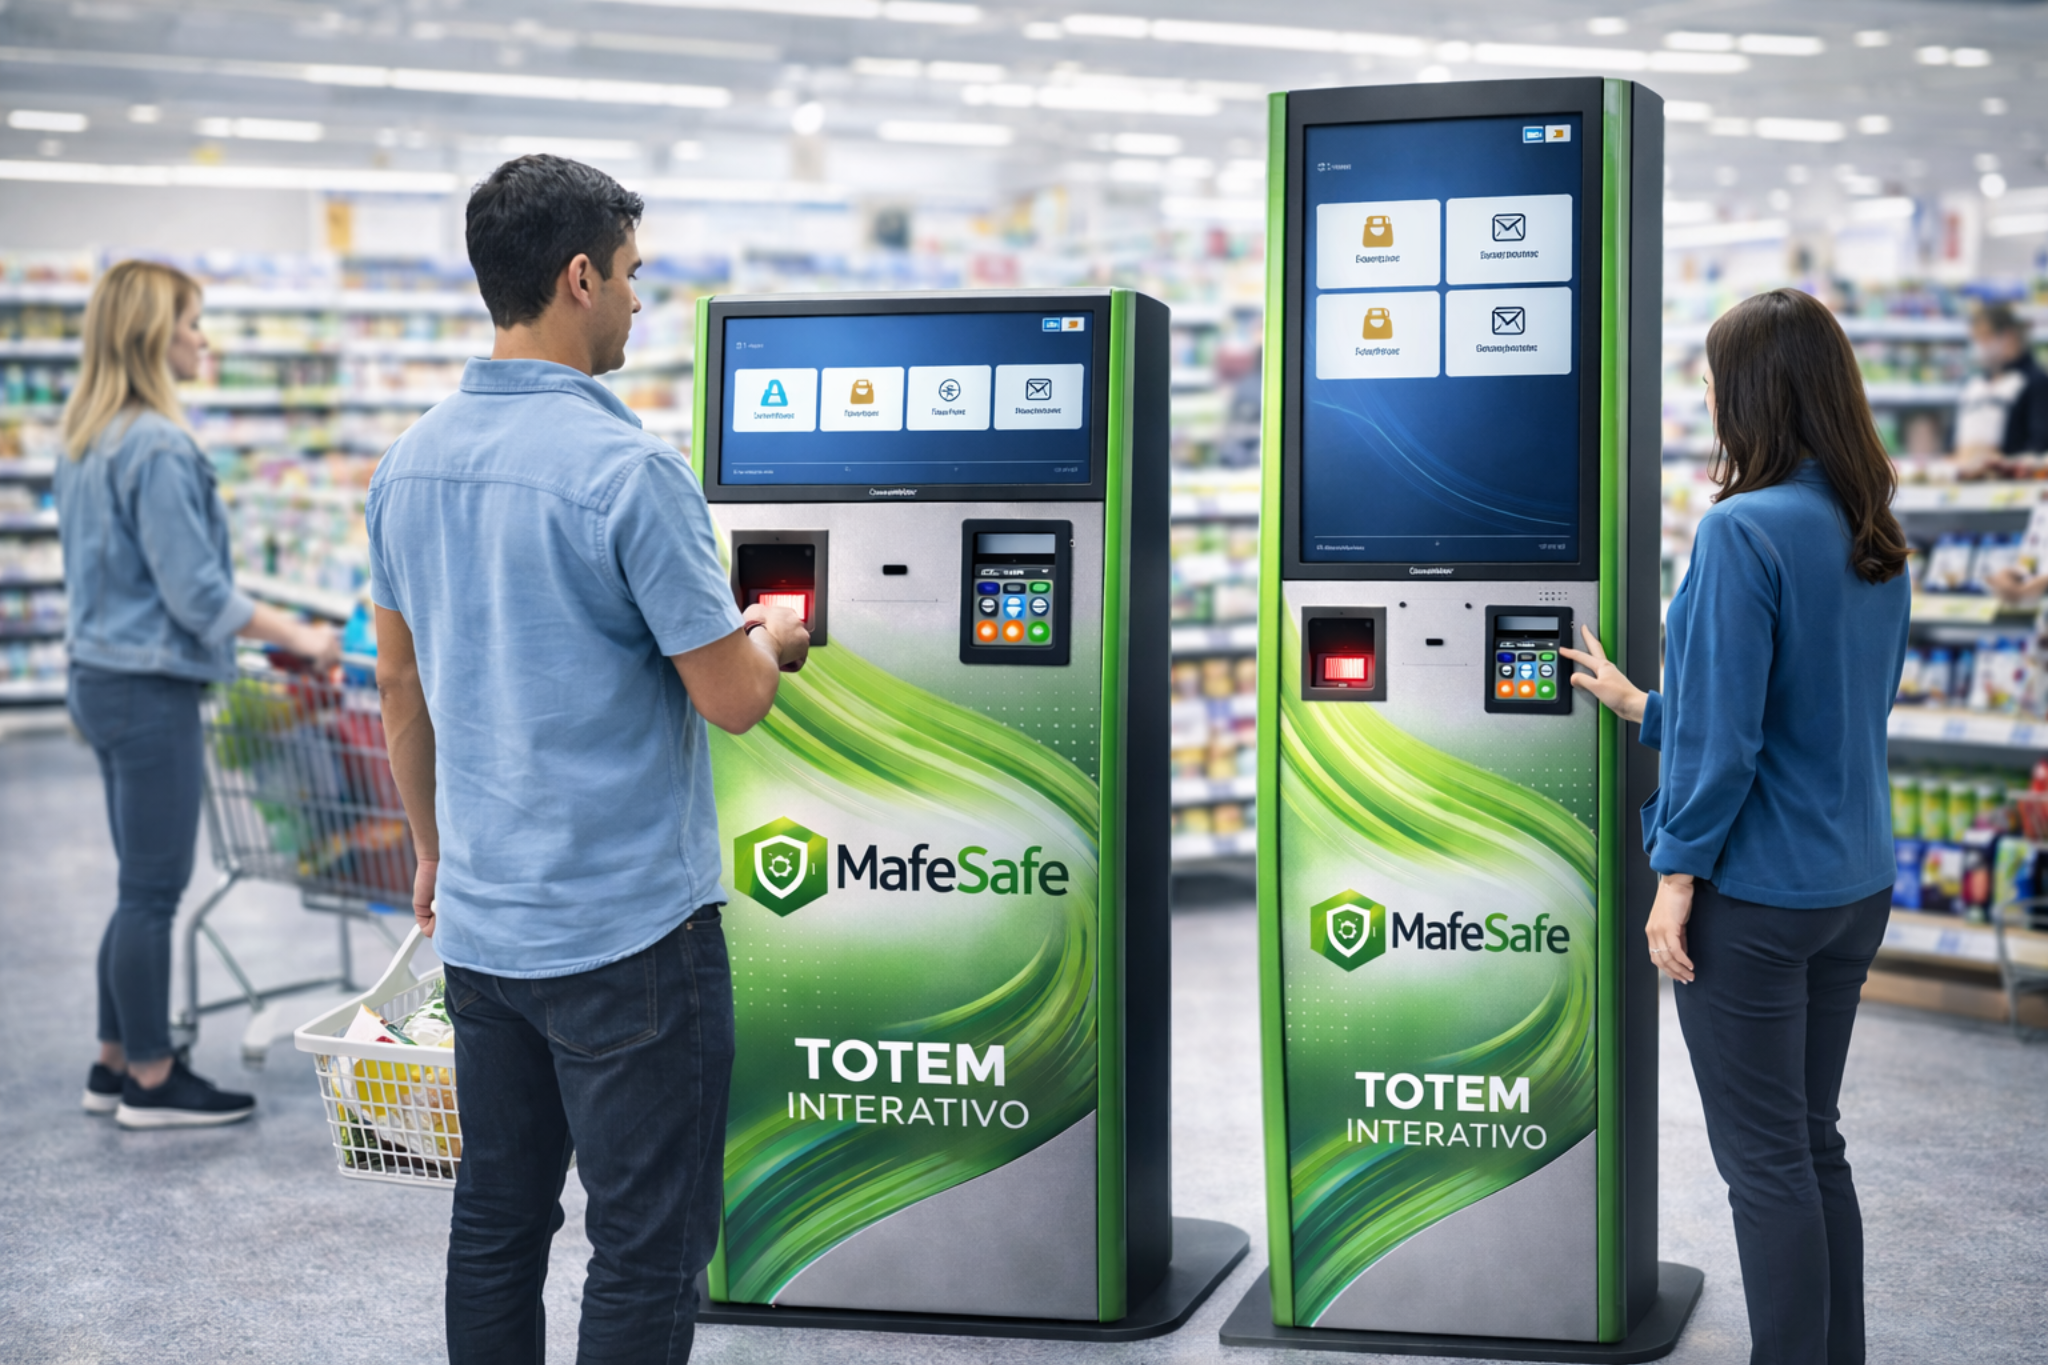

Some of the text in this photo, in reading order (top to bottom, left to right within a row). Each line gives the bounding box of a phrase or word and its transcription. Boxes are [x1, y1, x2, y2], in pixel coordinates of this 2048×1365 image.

[837, 843, 1070, 897] MafeSafe
[1391, 911, 1570, 955] MafeSafe
[795, 1038, 1005, 1087] TOTEM
[788, 1091, 1029, 1130] INTERATIVO
[1355, 1072, 1530, 1114] TOTEM
[1346, 1117, 1547, 1151] INTERATIVO
